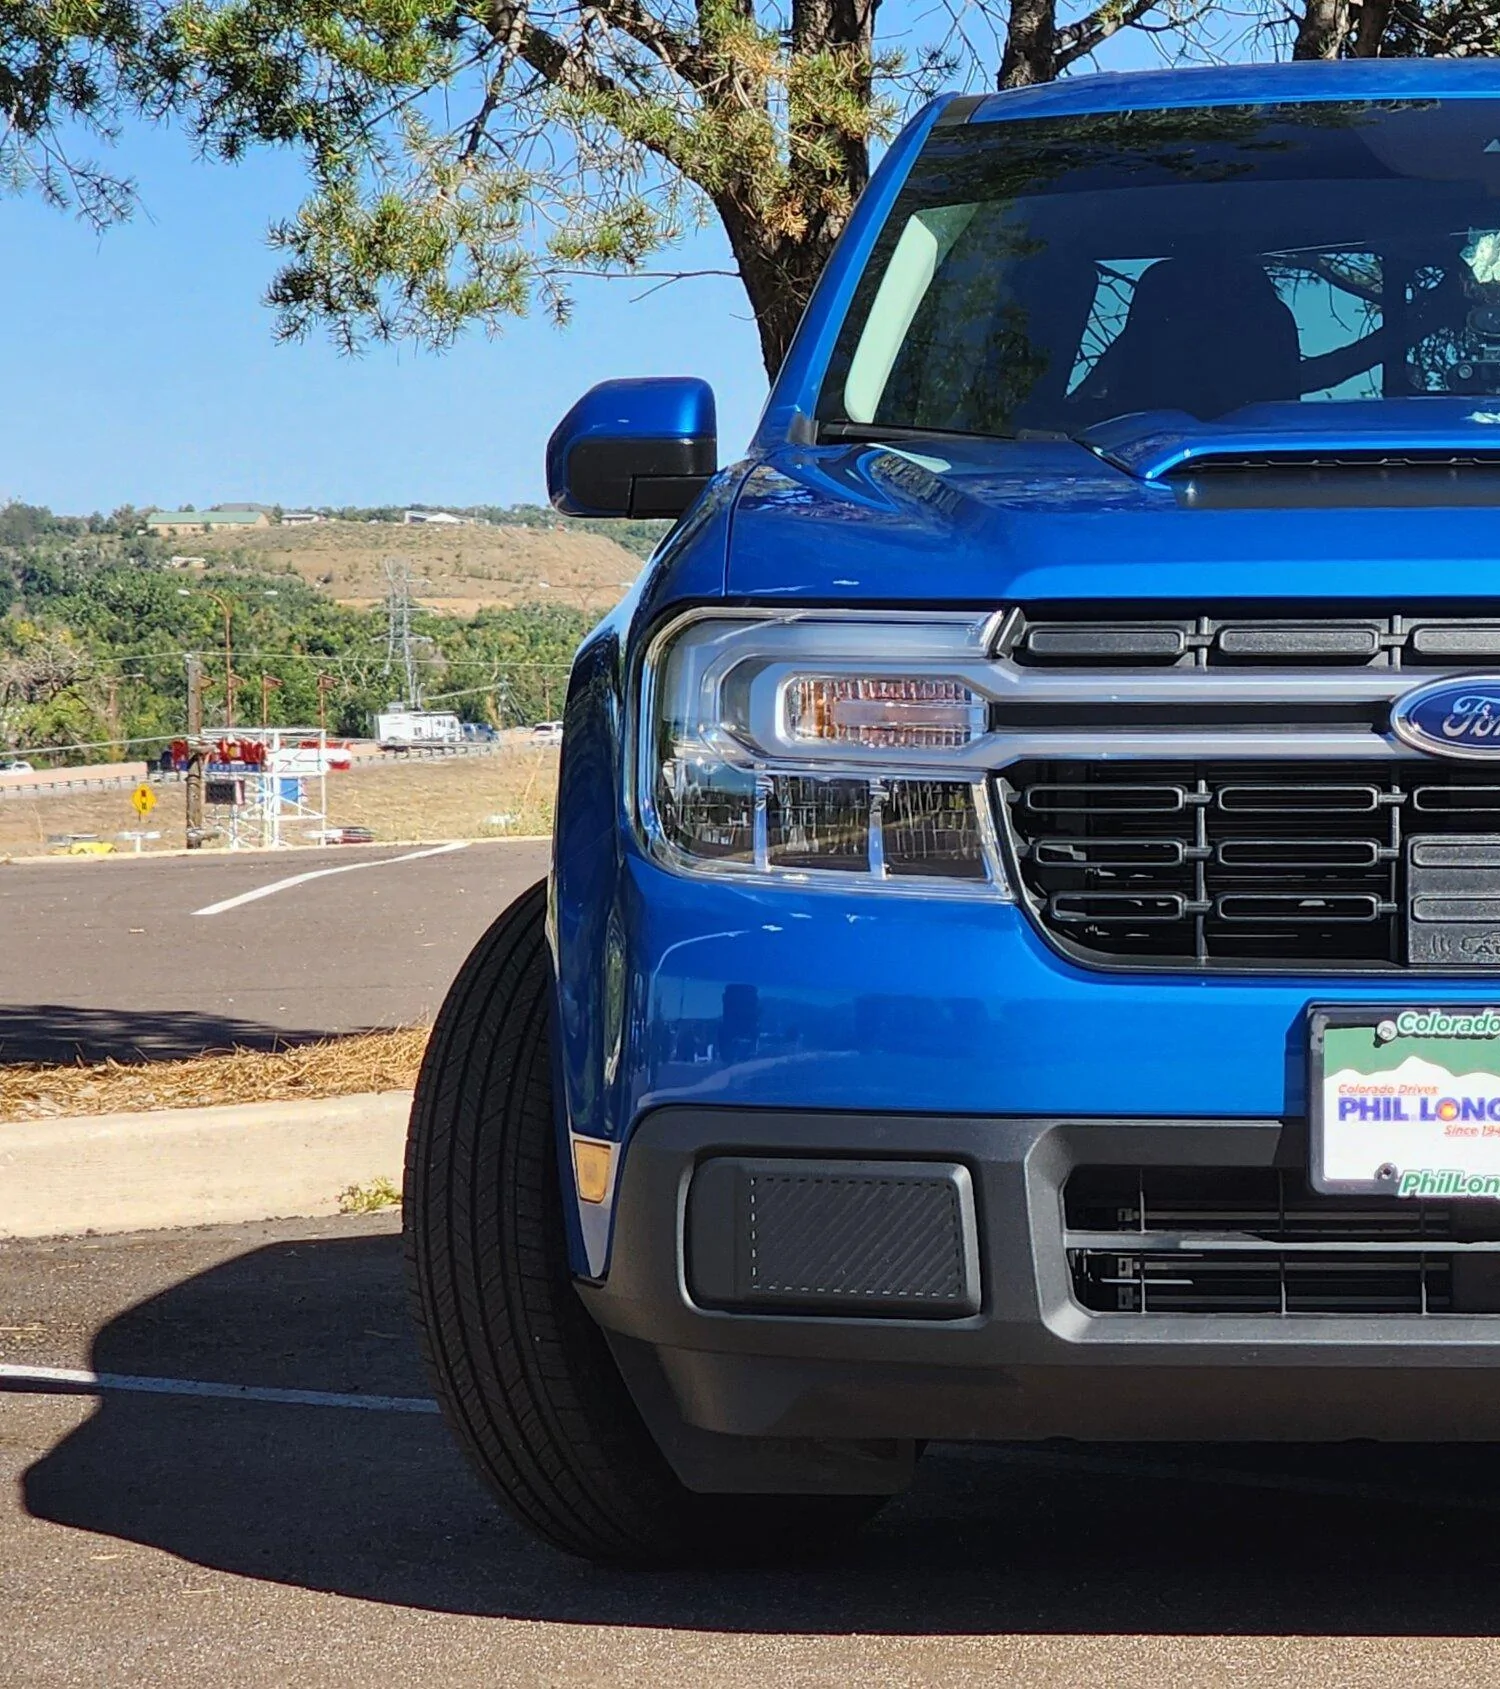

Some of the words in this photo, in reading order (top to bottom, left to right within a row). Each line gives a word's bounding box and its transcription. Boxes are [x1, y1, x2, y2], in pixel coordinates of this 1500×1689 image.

[1338, 1084, 1395, 1095] Colorado
[1398, 1084, 1439, 1095] Drives
[1338, 1097, 1409, 1121] PHIL
[1443, 1125, 1479, 1136] Since
